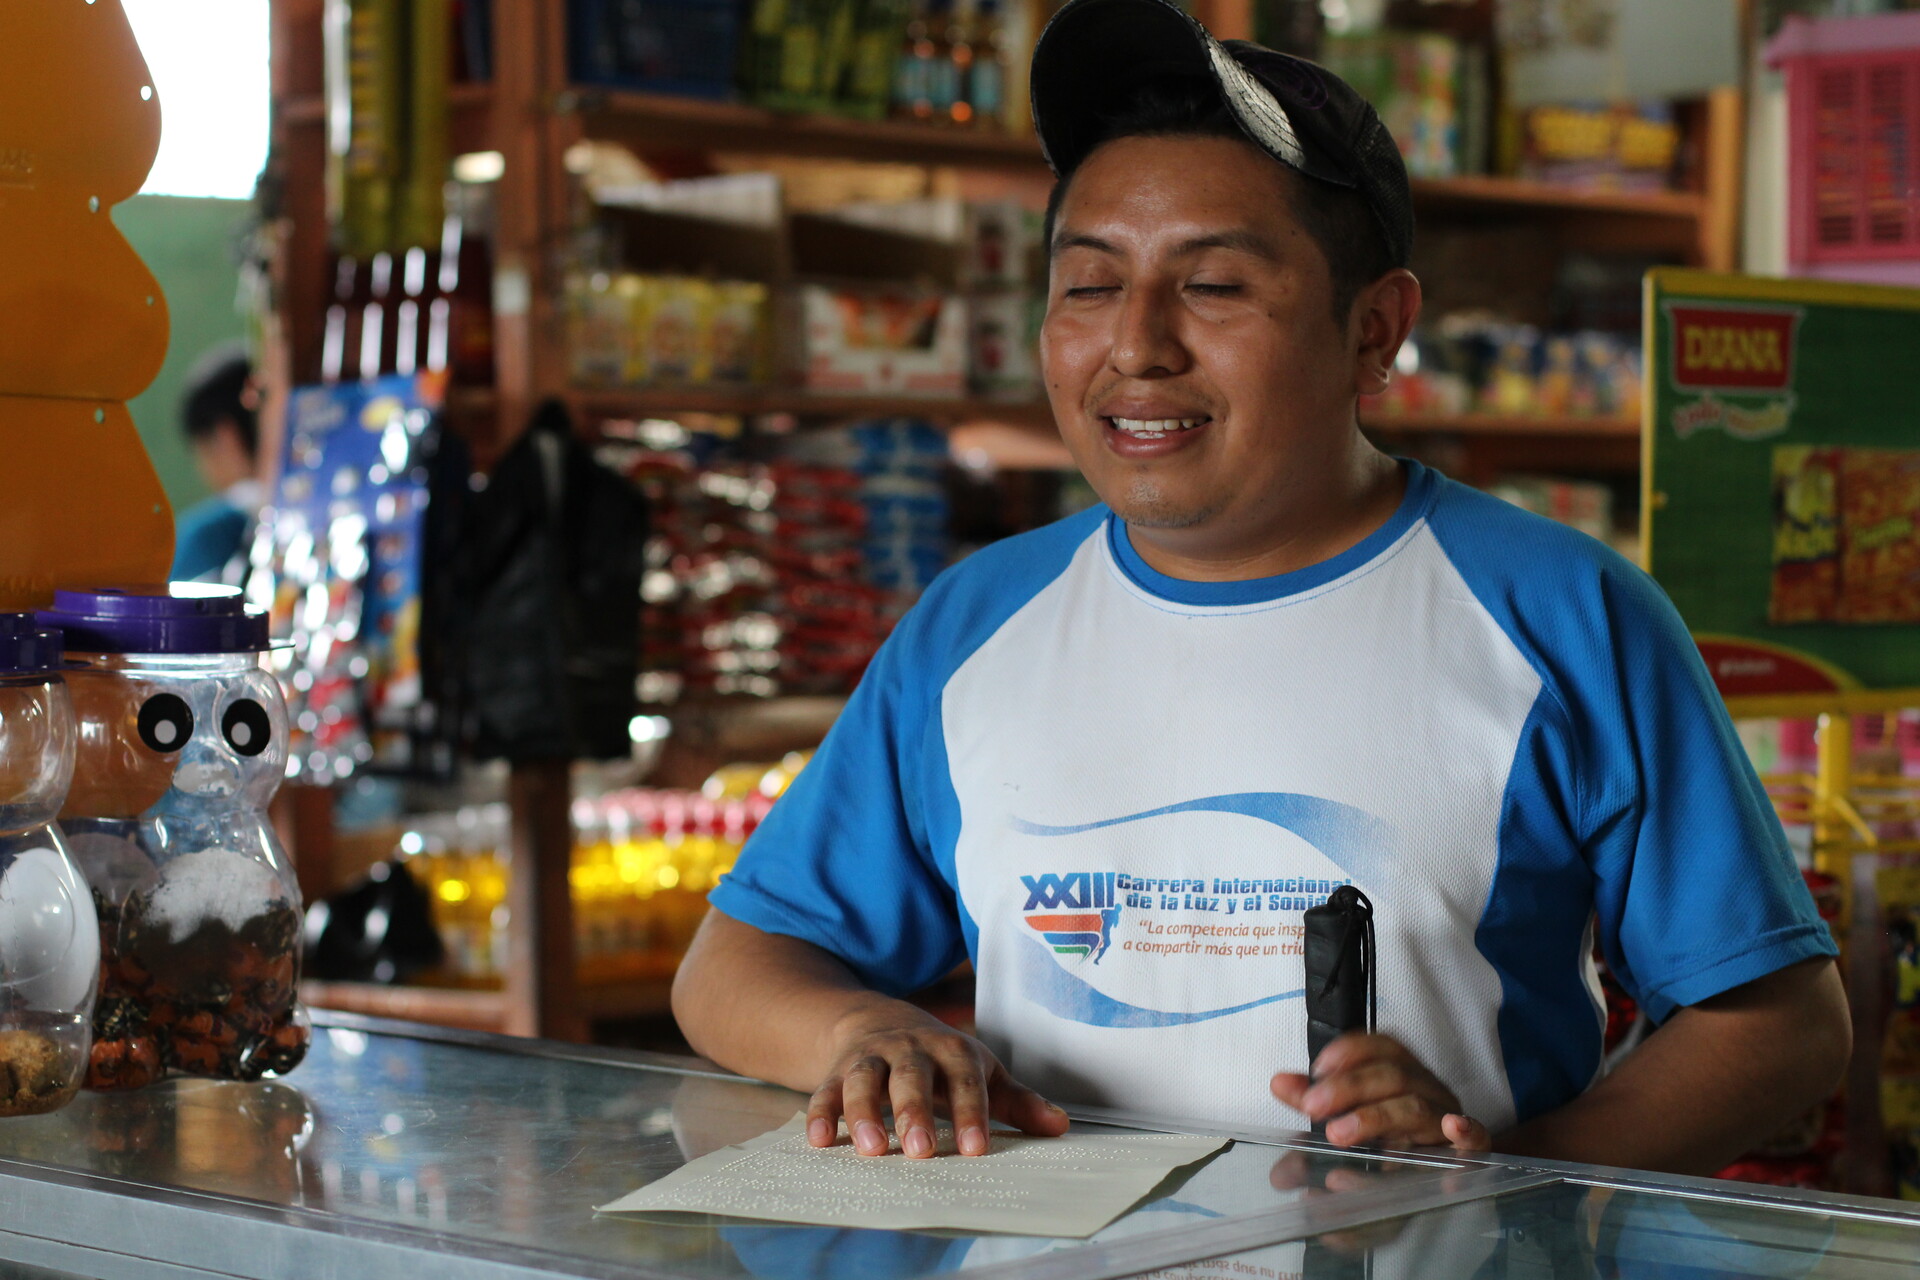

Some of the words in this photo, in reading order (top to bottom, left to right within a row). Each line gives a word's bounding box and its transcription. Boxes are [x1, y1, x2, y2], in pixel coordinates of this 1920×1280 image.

[1683, 325, 1784, 373] DIANA
[1019, 872, 1116, 911] XXIII
[1117, 873, 1205, 893] Carrera
[1126, 893, 1152, 909] de
[1160, 894, 1179, 910] la
[1184, 894, 1219, 911] Luz
[1225, 898, 1238, 914] y
[1243, 895, 1262, 911] el
[1269, 894, 1328, 911] Sonid
[1167, 923, 1249, 938] competencia
[1252, 925, 1275, 940] que
[1278, 922, 1306, 940] insp
[1123, 940, 1132, 951] a
[1135, 940, 1202, 957] compartir
[1204, 941, 1233, 956] más
[1235, 944, 1260, 959] que
[1263, 945, 1278, 956] un
[1281, 941, 1305, 956] triu
